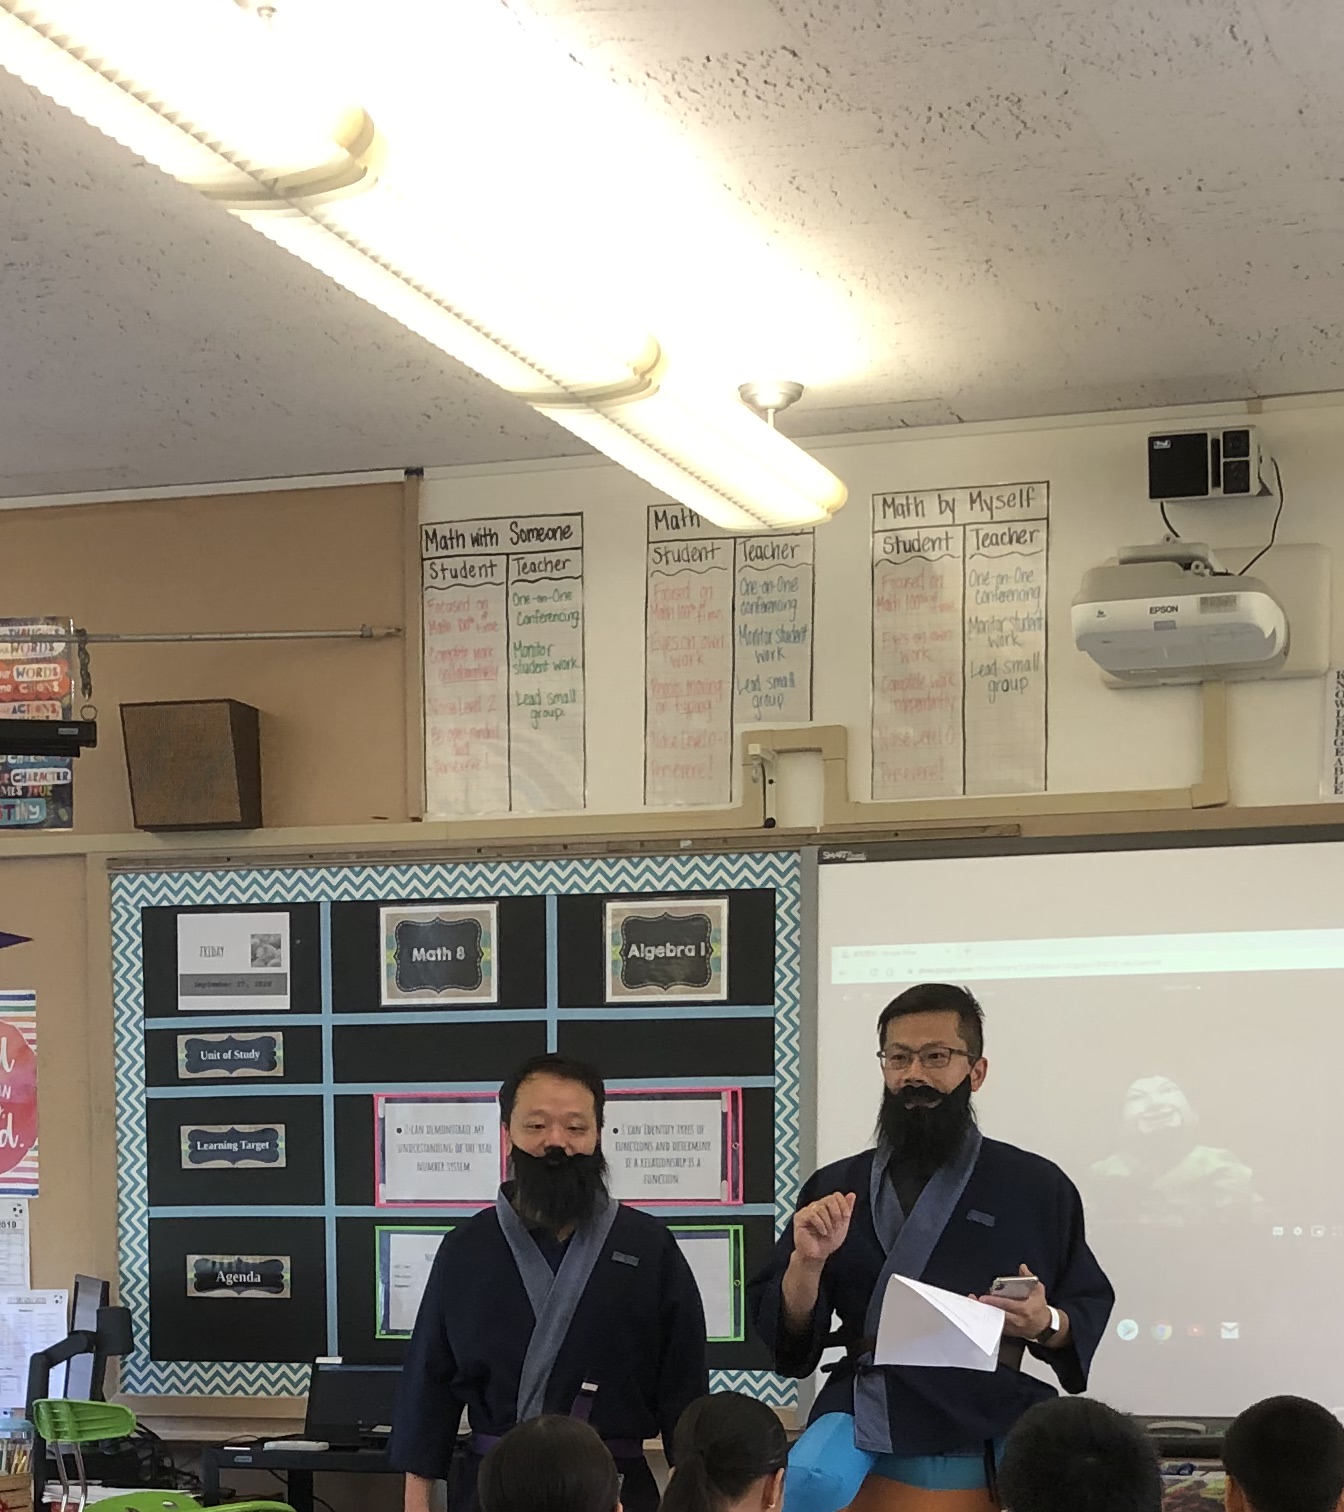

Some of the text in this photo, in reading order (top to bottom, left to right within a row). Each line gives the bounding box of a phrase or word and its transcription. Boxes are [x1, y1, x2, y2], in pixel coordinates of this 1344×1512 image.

[882, 487, 1035, 523] Math by Myself
[653, 509, 701, 531] Math
[425, 521, 573, 552] Math with Someone
[883, 531, 954, 554] Student
[970, 527, 1040, 550] Teacher
[651, 541, 721, 565] Student
[737, 538, 800, 562] Teacher
[429, 561, 498, 581] Student
[512, 557, 571, 576] Teacher
[1149, 605, 1179, 615] EPSON
[1006, 651, 1040, 674] small
[16, 667, 60, 679] WORDS
[988, 676, 1029, 704] group
[199, 946, 225, 958] FRIDAY
[412, 946, 466, 962] Math 8
[628, 942, 696, 961] Algebra
[200, 1049, 261, 1062] Unit of Study
[196, 1140, 270, 1153] Learning Target
[216, 1271, 262, 1286] Agenda
